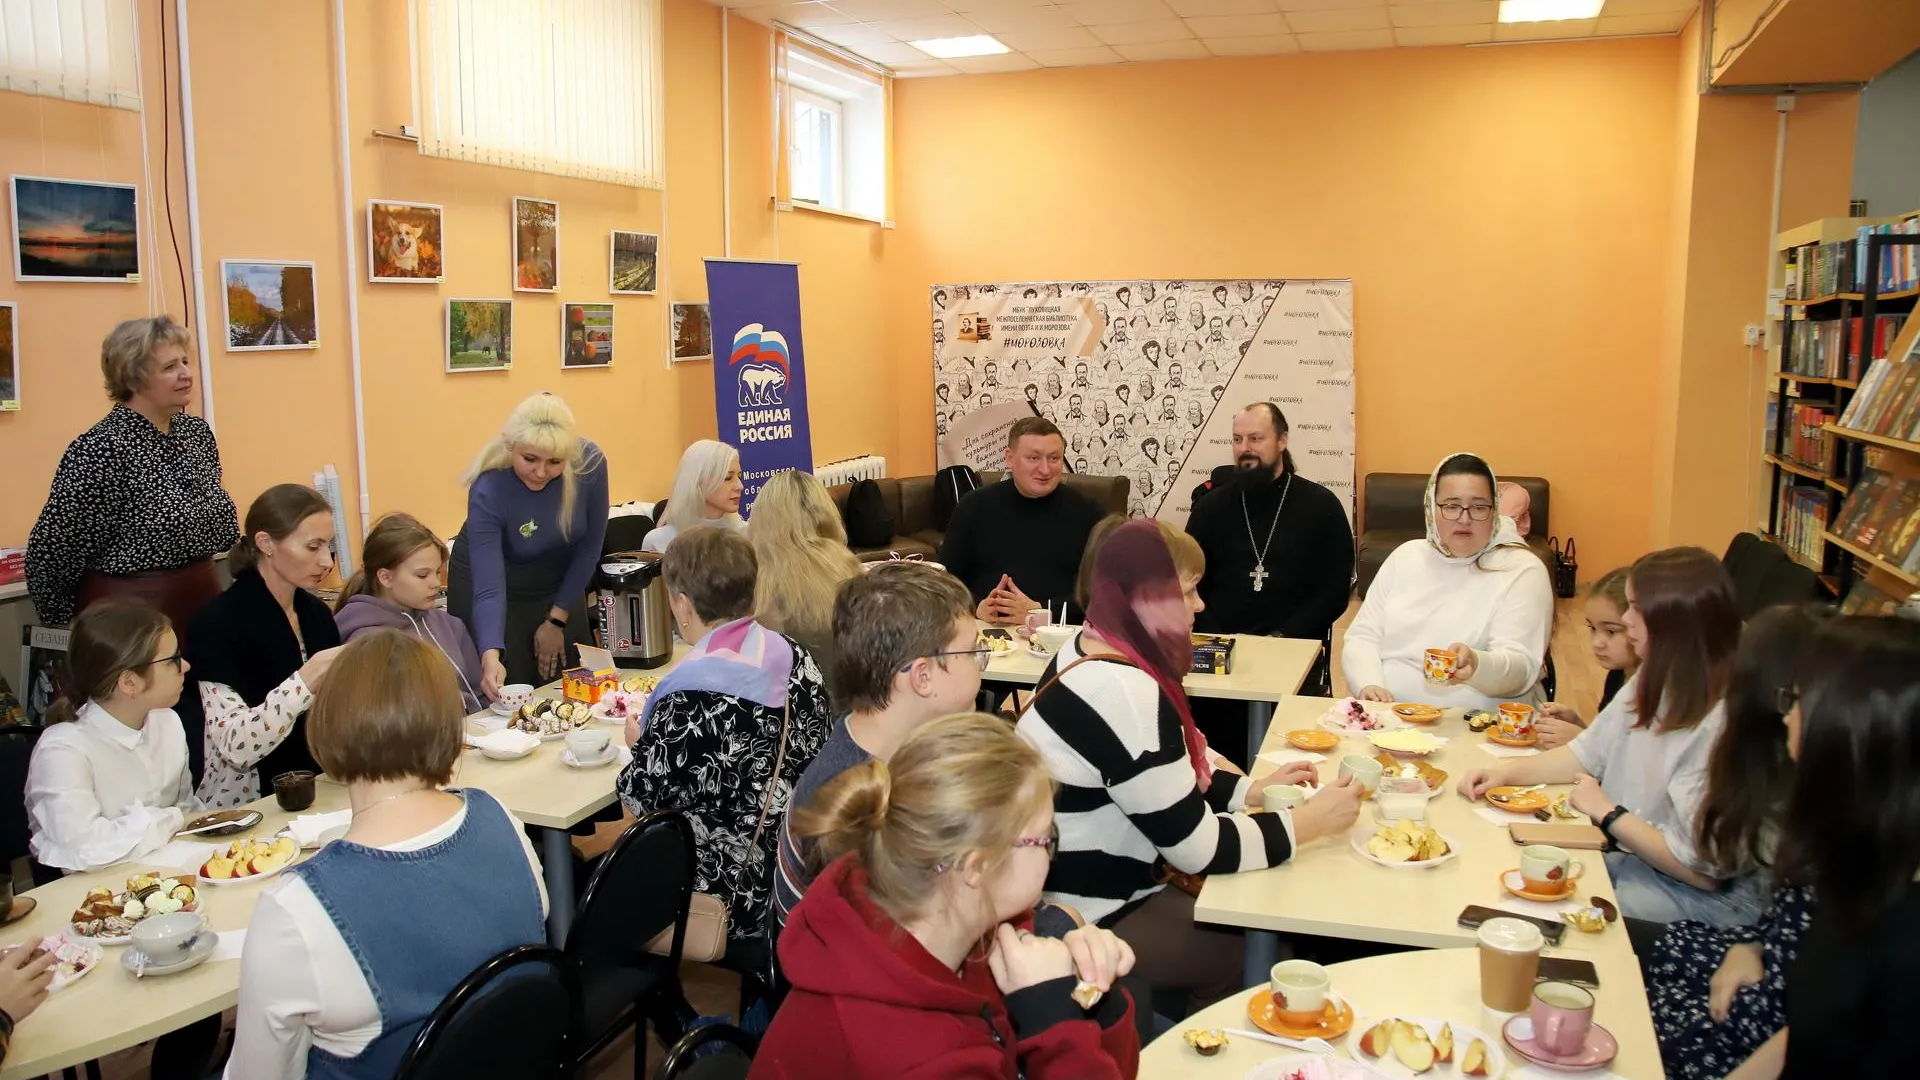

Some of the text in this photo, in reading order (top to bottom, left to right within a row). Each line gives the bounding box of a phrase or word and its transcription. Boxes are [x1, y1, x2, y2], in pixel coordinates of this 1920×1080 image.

[1045, 314, 1078, 322] БИБЛИОТЕКА
[1001, 324, 1018, 332] ИМЕНИ
[1004, 337, 1066, 351] #МОРОЗОВКА
[737, 408, 791, 427] ЕДИНАЯ
[739, 424, 793, 444] РОССИЯ
[976, 450, 997, 464] важно
